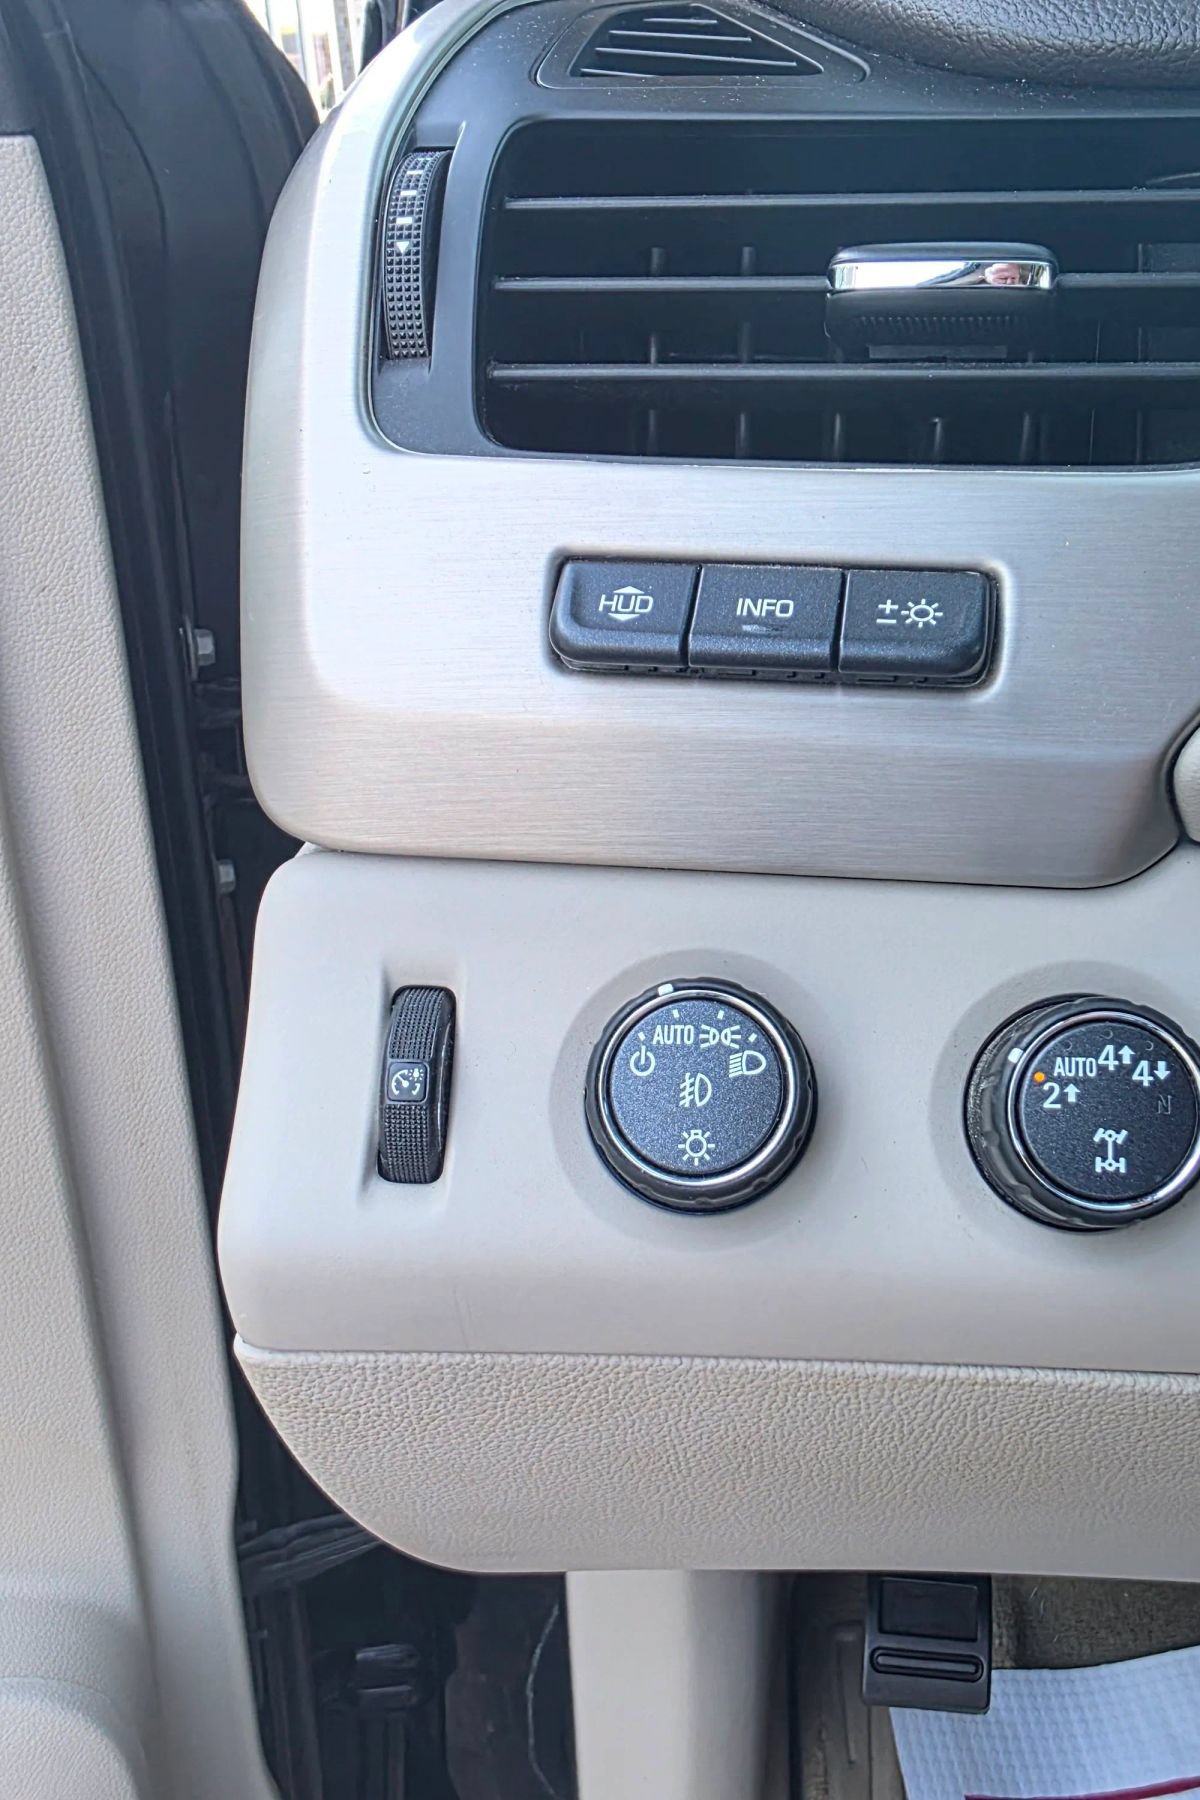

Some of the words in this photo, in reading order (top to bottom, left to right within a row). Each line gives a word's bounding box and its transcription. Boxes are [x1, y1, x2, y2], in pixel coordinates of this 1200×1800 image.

[598, 593, 654, 614] HUD
[736, 598, 795, 618] INFO
[652, 1024, 695, 1046] AUTO
[1053, 1056, 1097, 1078] AUTO
[1097, 1044, 1119, 1072] 4
[1131, 1060, 1154, 1087] 4
[1042, 1081, 1062, 1109] 2
